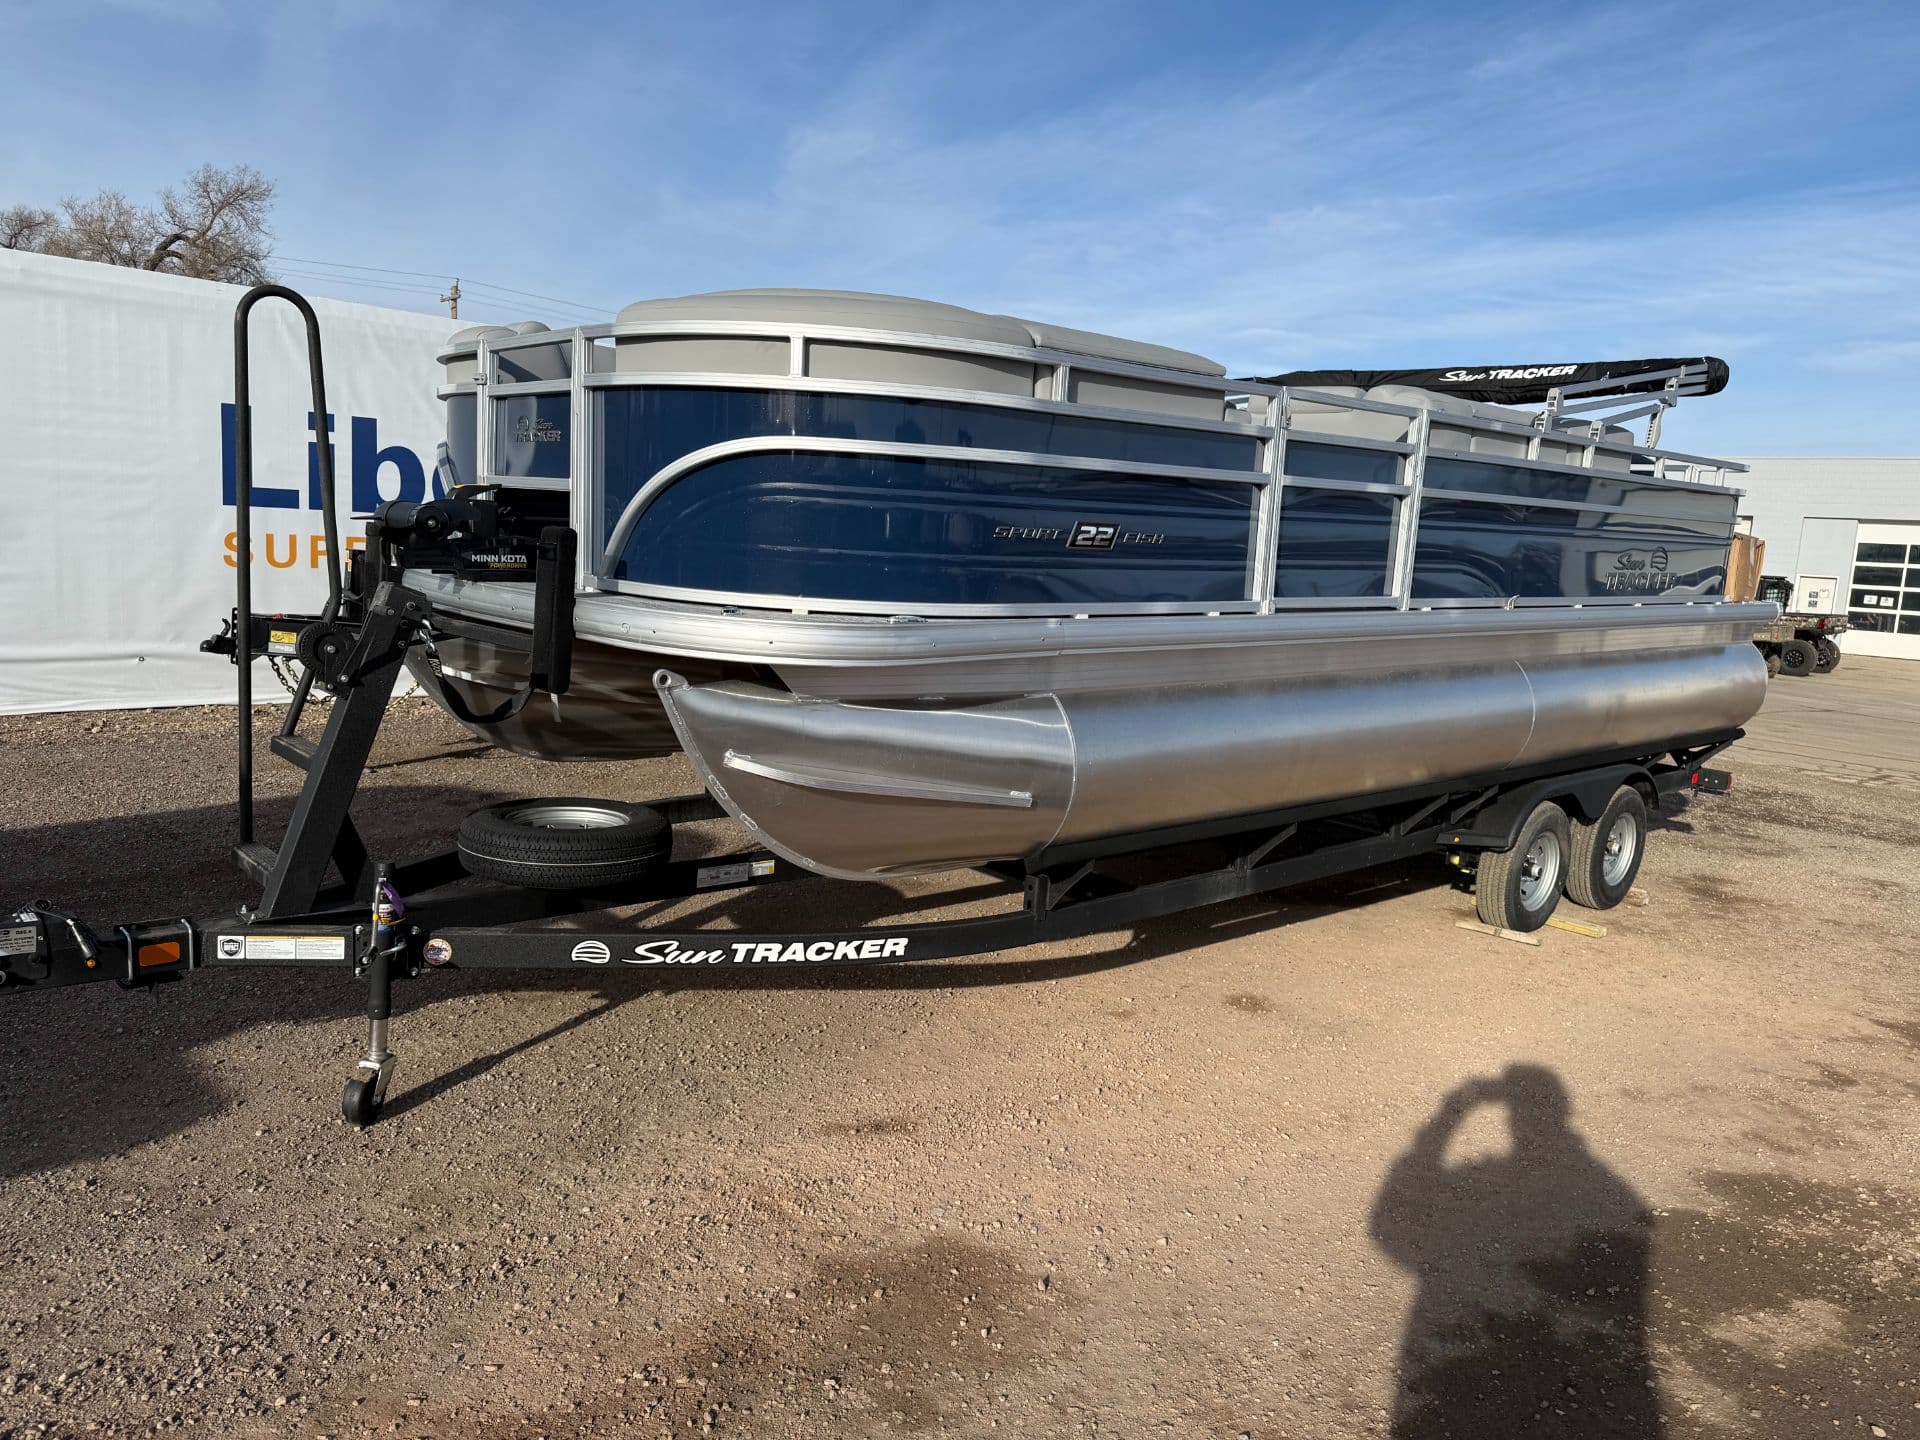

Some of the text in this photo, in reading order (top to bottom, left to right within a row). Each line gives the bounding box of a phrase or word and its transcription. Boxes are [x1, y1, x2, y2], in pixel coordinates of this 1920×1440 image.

[1438, 364, 1578, 382] Sun TRACKER
[993, 525, 1167, 546] SPORT 22 FISH
[471, 554, 527, 563] MINN KOTA
[1605, 571, 1678, 590] TRACKER
[621, 937, 909, 964] Sun TRACKER
